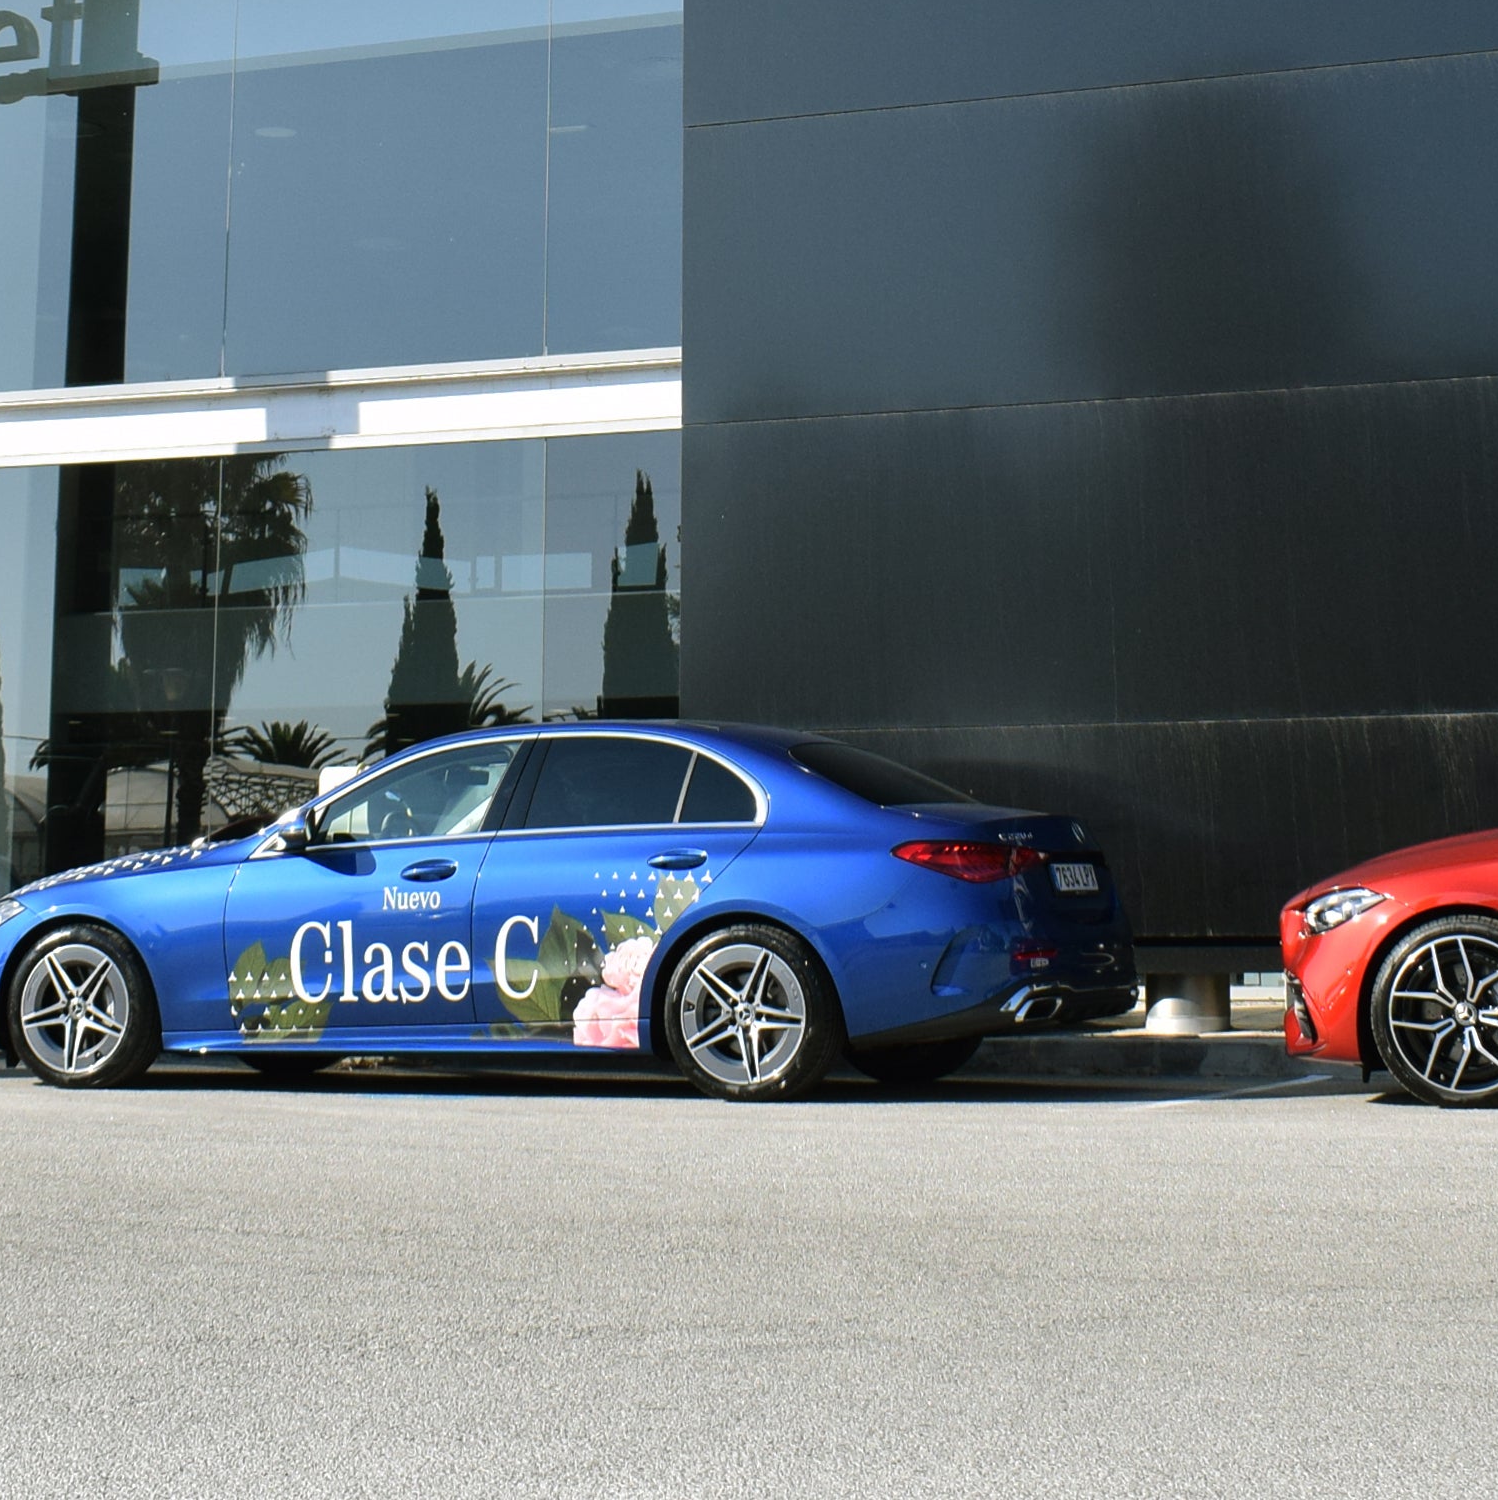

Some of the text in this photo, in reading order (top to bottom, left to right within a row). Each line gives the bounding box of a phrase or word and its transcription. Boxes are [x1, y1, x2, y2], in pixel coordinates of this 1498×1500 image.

[382, 887, 441, 910] Nuevo
[290, 915, 539, 1004] Clase C
